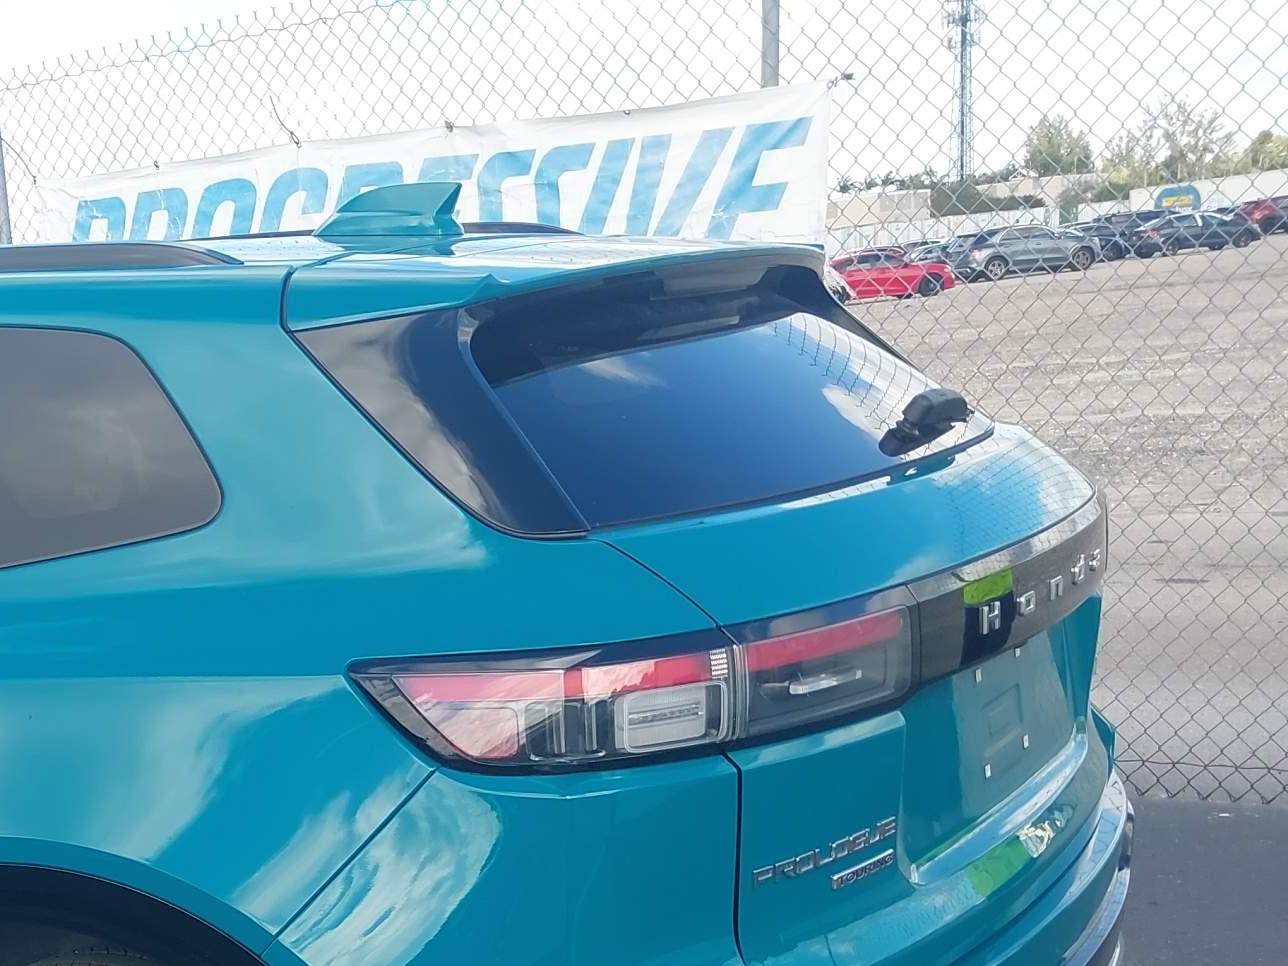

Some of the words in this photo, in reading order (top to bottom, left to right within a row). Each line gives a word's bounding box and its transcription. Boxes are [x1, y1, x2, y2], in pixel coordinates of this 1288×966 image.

[72, 117, 810, 243] PROGSSIVE
[752, 816, 896, 888] PROLOGUE
[835, 852, 895, 887] TOURING
